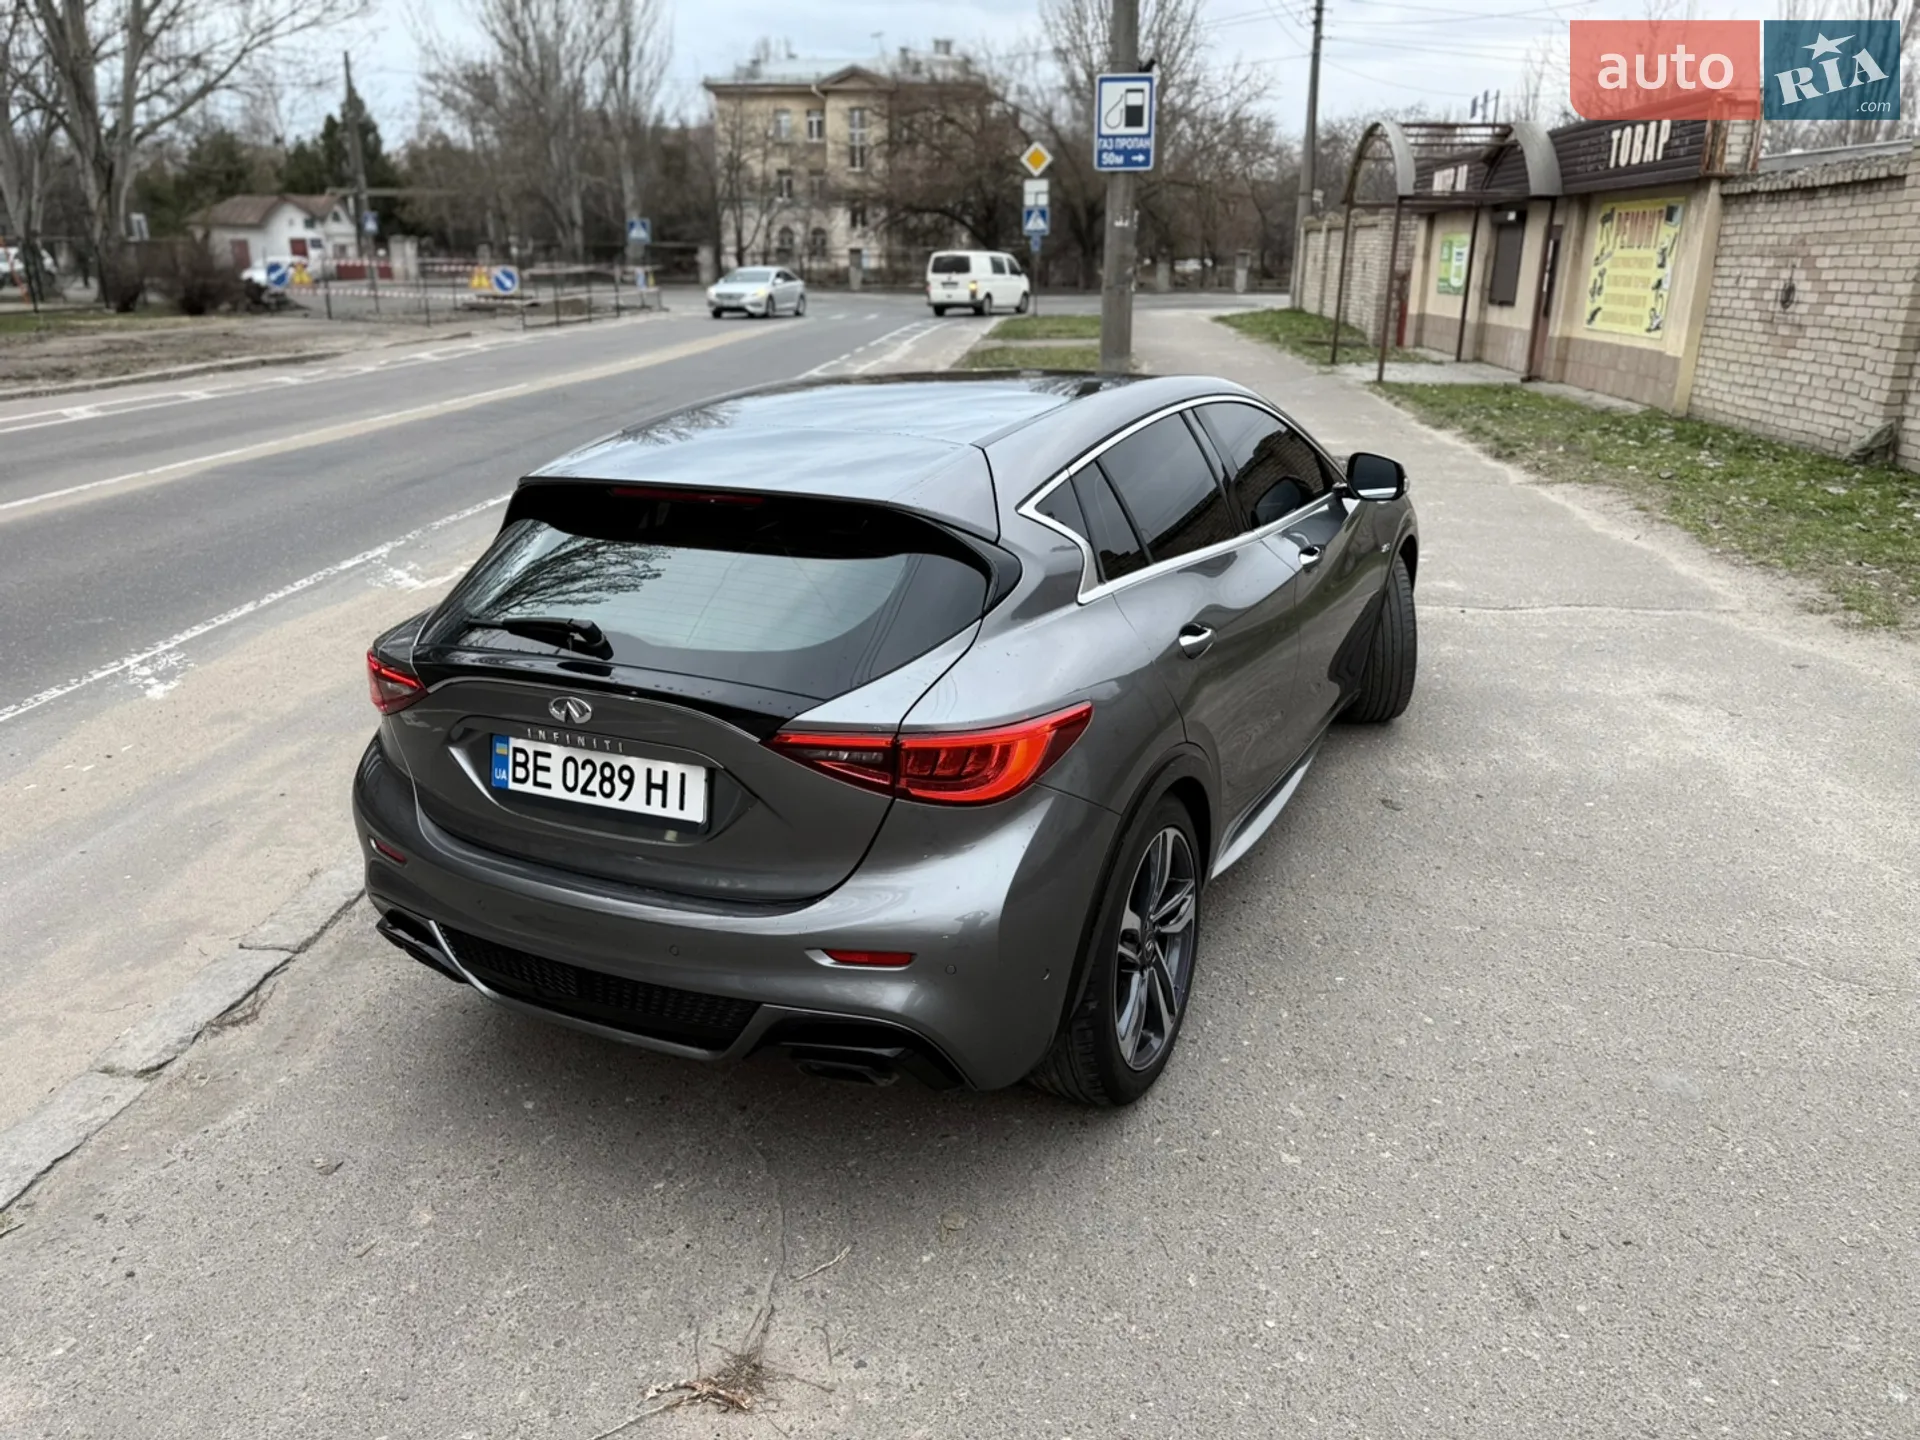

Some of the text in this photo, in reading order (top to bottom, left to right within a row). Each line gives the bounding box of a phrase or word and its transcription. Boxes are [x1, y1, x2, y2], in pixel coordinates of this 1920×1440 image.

[1099, 137, 1151, 150] ГАЗ ПРОПАН
[1609, 118, 1672, 169] ТОВАР
[1613, 208, 1665, 250] РЕМОНТ
[527, 728, 623, 753] INFINITI
[494, 768, 508, 780] UA
[511, 747, 686, 811] BE 0289 HI
